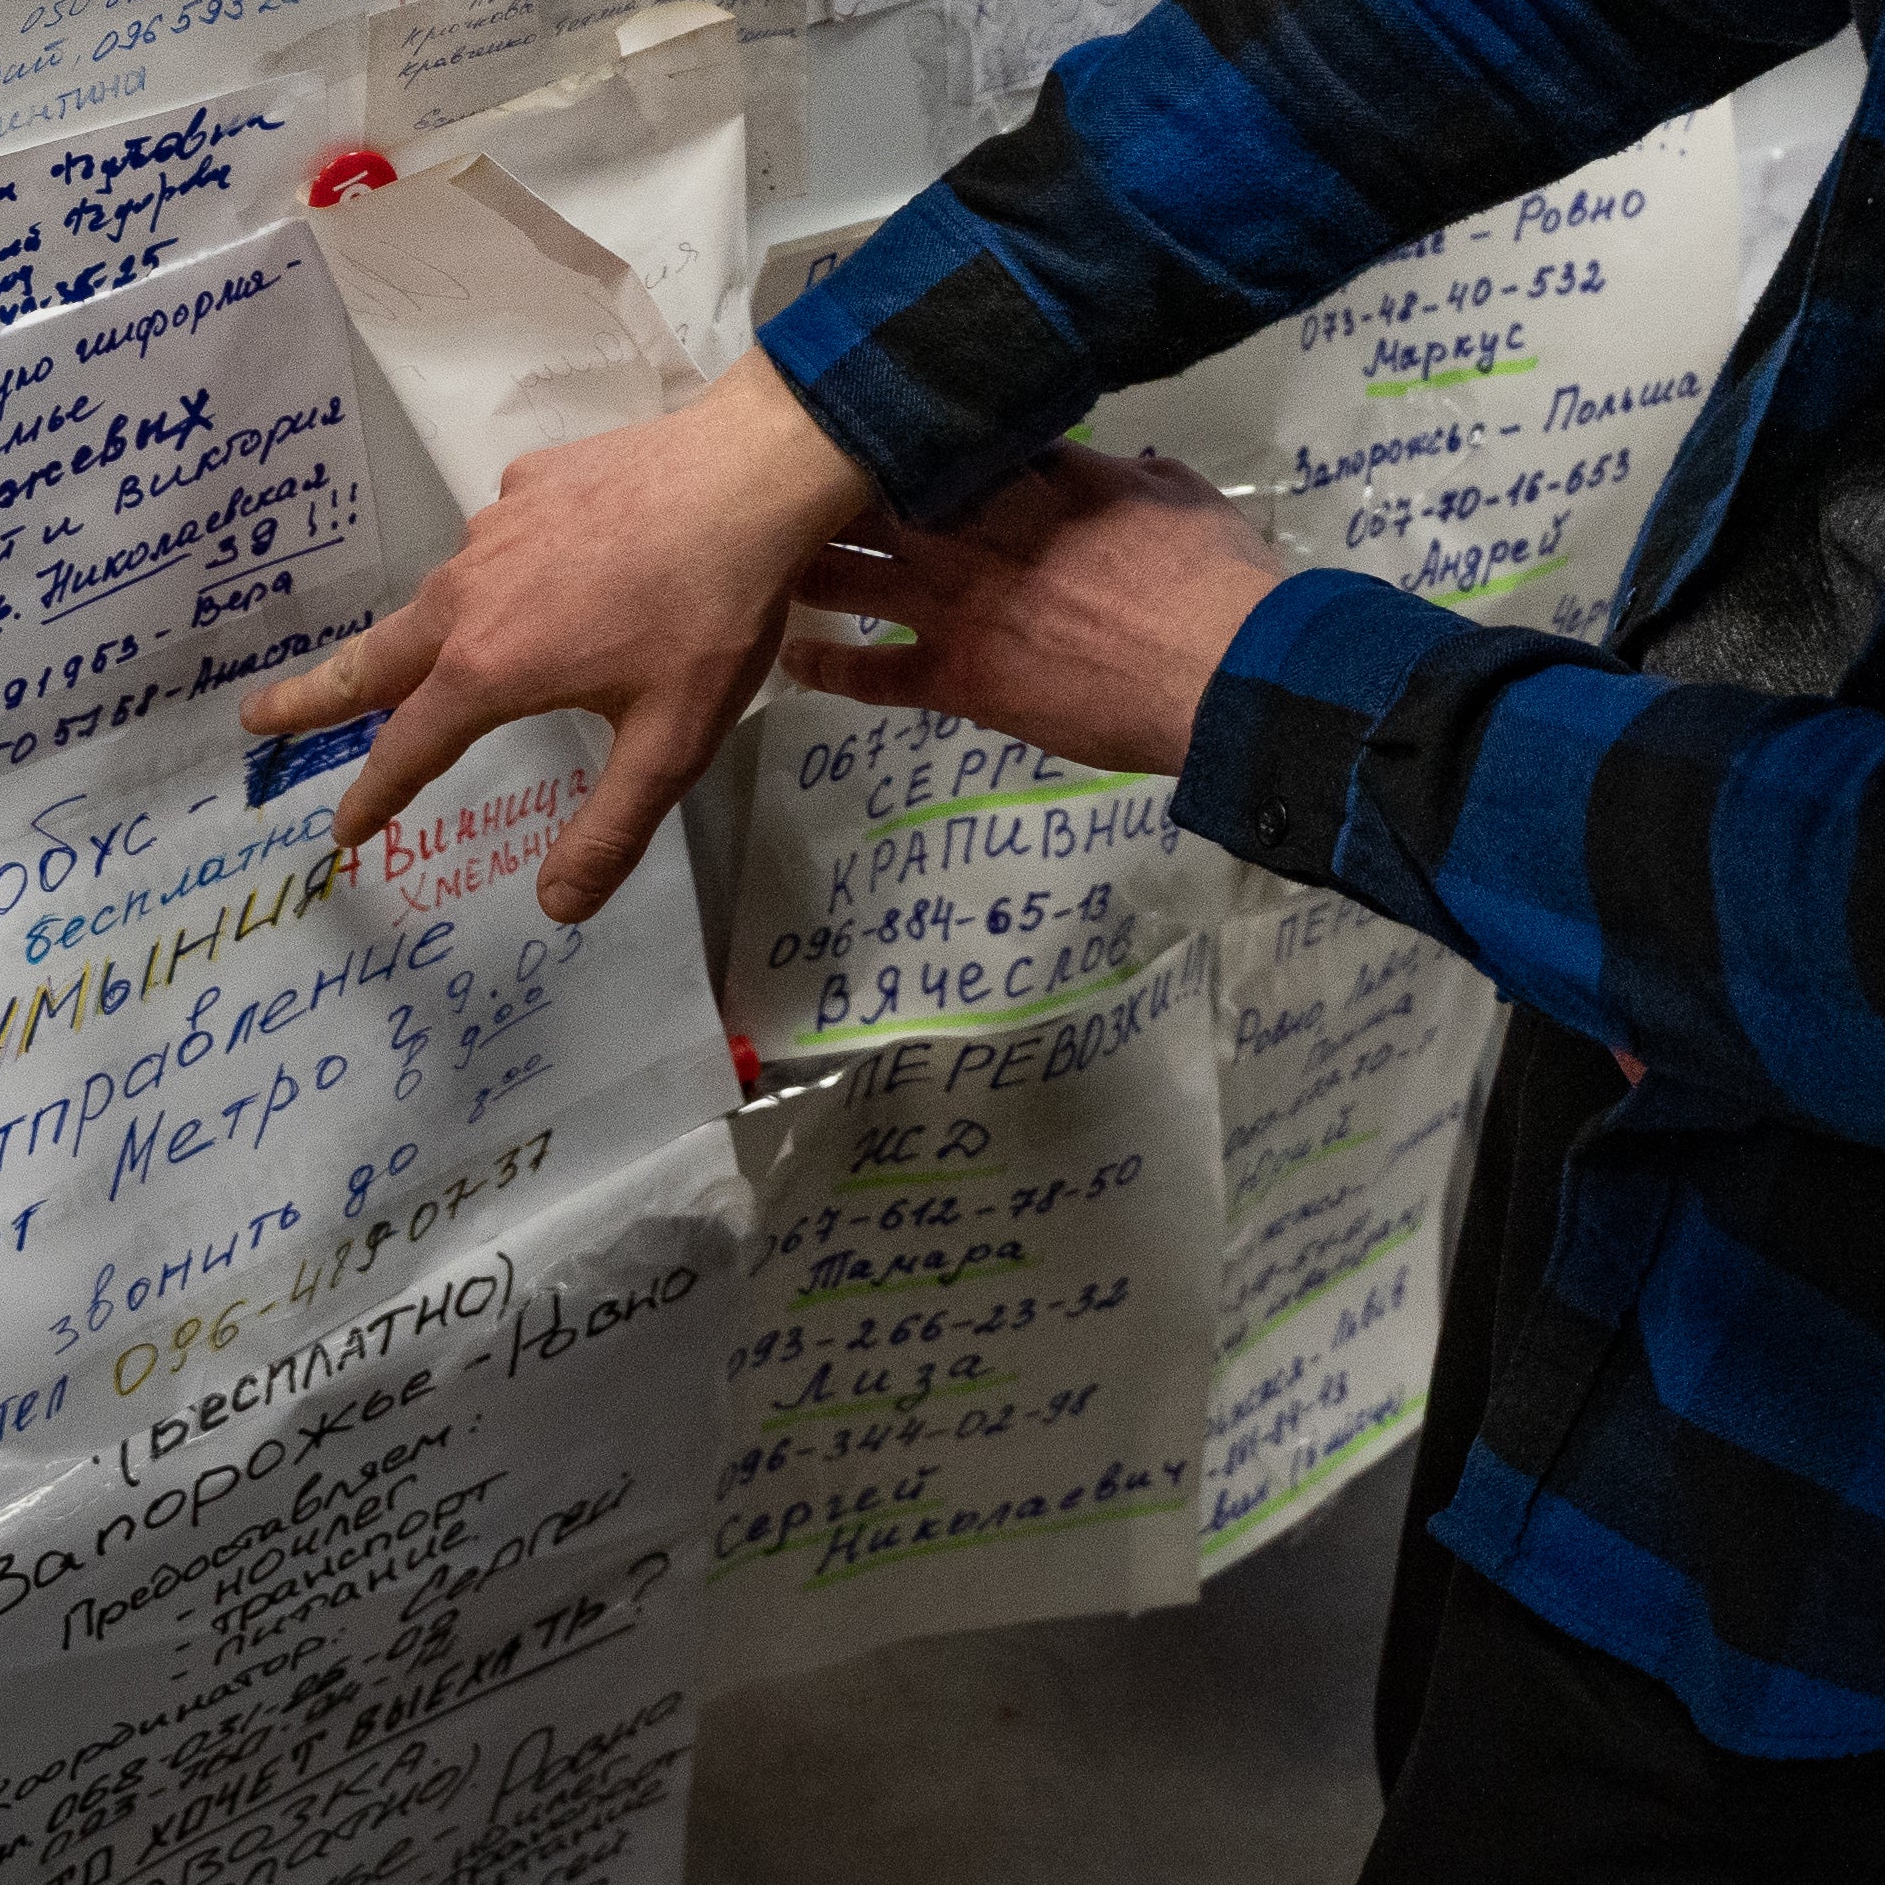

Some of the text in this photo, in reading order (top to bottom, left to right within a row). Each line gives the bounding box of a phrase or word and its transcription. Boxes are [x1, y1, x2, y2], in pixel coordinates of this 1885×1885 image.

[1513, 190, 1645, 243] Ровно
[1362, 322, 1525, 381] Маркус
[1545, 372, 1701, 432] Польша
[114, 396, 345, 515] Виктория
[1400, 510, 1571, 593] Андрей
[191, 569, 295, 630] Вера
[108, 1051, 348, 1205] Метро
[47, 1141, 418, 1356] звонить до
[798, 1240, 1025, 1296] Тамара
[774, 1353, 994, 1412] Лиза
